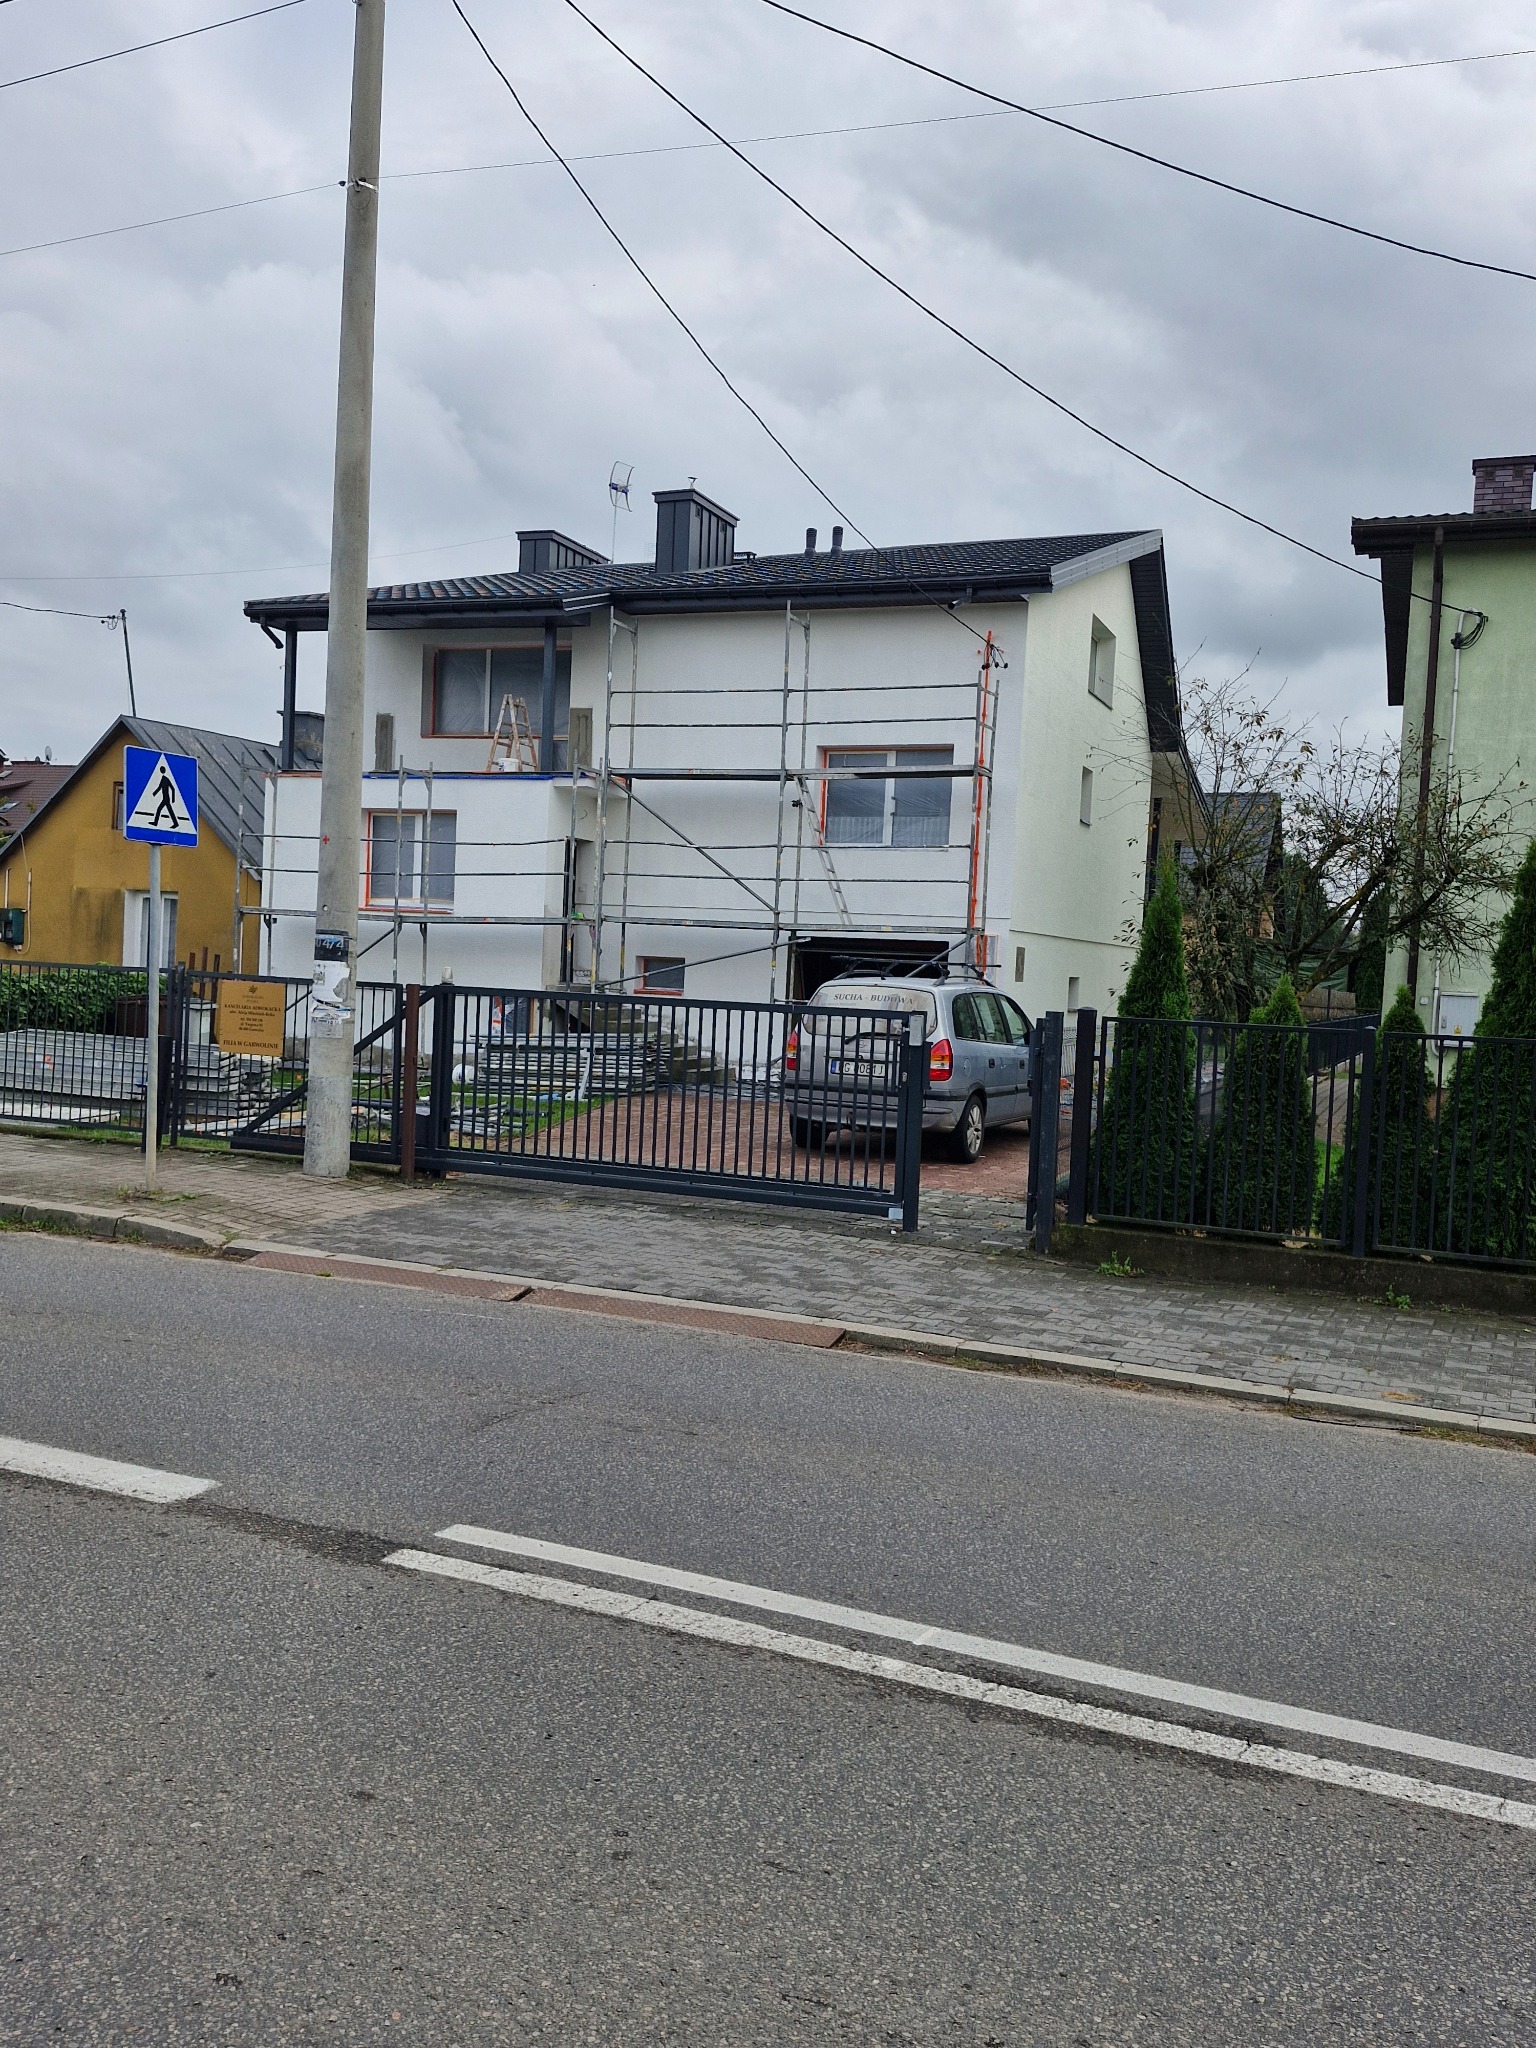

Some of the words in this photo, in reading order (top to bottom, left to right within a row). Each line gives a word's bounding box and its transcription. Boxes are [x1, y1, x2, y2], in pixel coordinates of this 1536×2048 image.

[833, 993, 863, 1001] SUCHA
[870, 994, 913, 1005] BUDOWA
[854, 1063, 883, 1075] 081J
